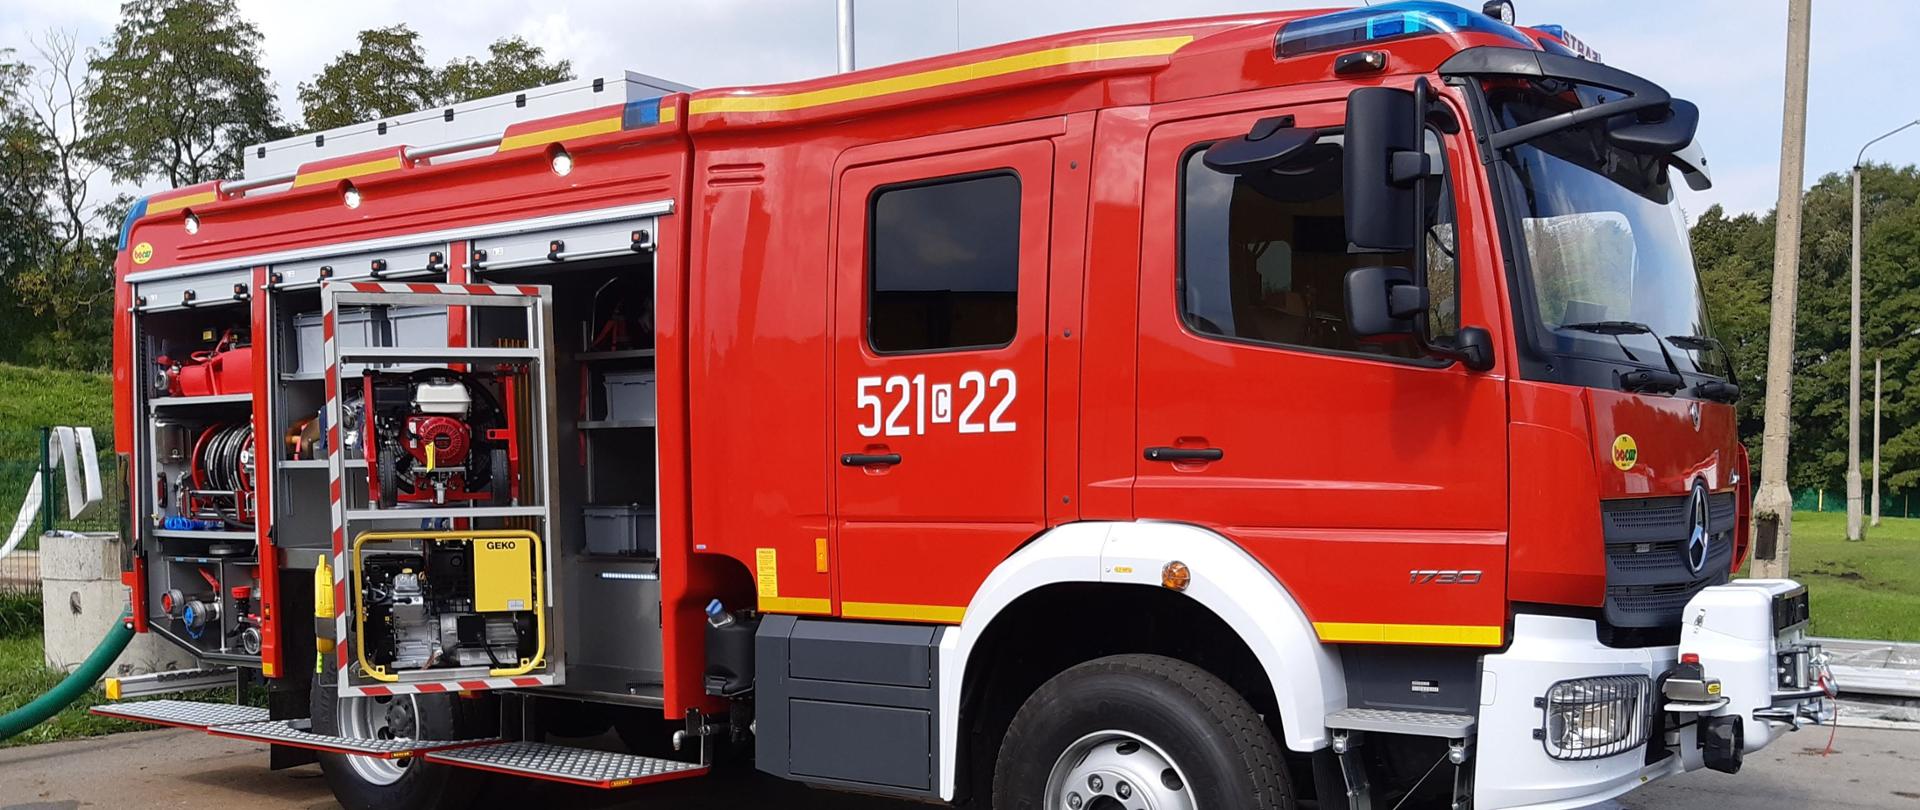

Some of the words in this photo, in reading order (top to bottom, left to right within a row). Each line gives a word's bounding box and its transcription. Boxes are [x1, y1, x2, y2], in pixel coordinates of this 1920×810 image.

[857, 374, 925, 437] 521
[934, 386, 949, 420] C
[958, 368, 1017, 433] 22
[486, 541, 516, 550] GEKO
[1408, 569, 1484, 585] 1730
